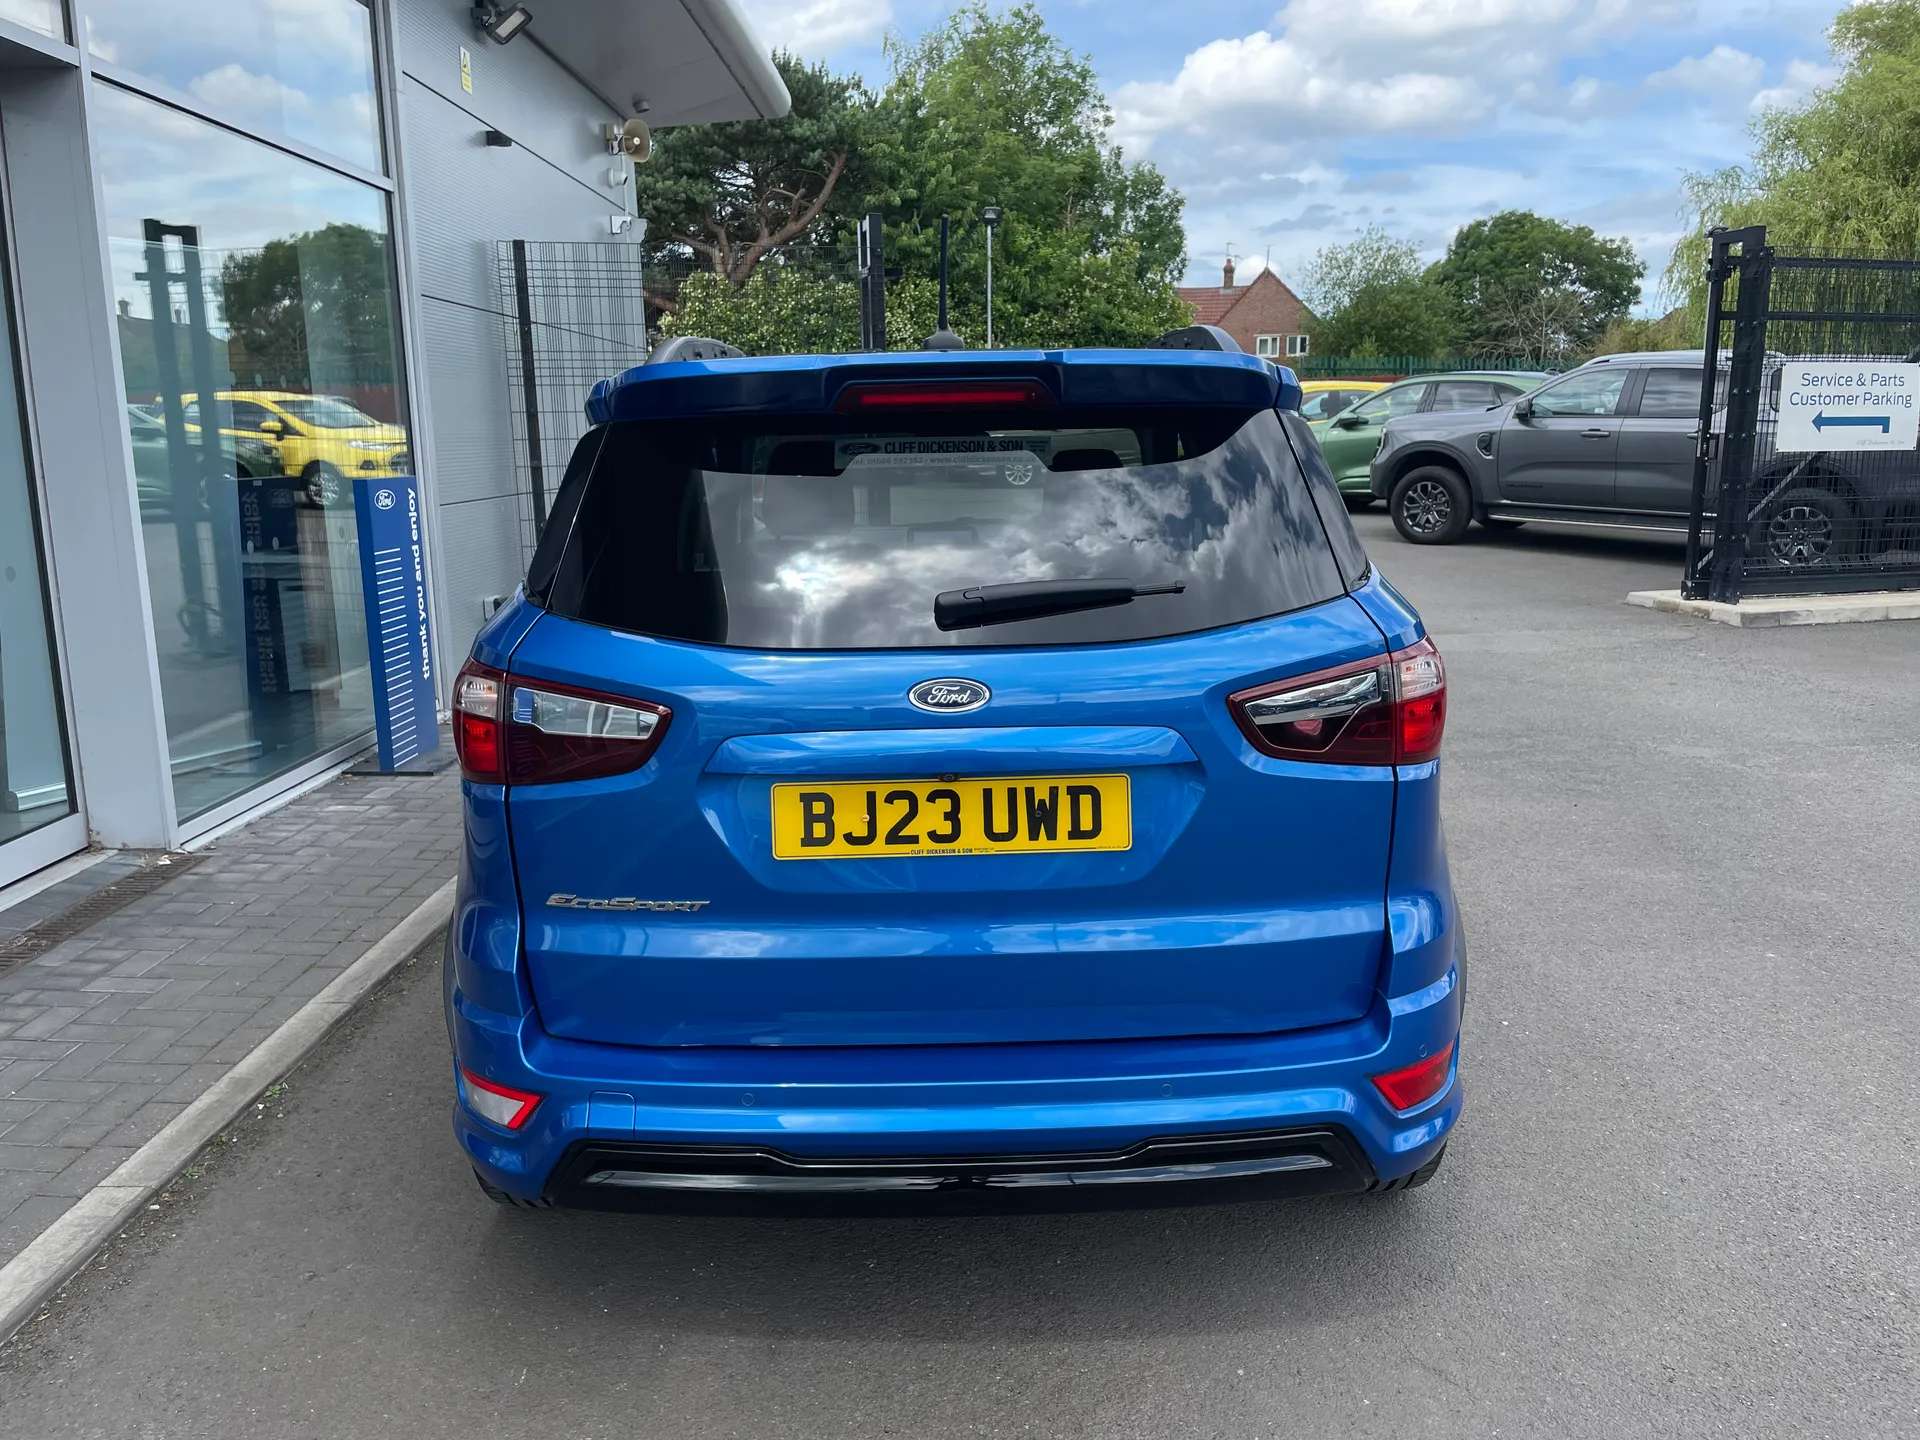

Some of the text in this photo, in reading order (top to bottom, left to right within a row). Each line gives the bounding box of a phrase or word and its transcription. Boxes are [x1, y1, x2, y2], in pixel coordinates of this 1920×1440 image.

[1800, 372, 1905, 387] Service & Parts
[1789, 391, 1912, 408] Customer Parking
[884, 441, 917, 454] CLIFF
[917, 440, 985, 454] DICKENSON
[986, 440, 998, 452] &
[998, 439, 1024, 452] SON
[407, 487, 431, 680] thank you and enjoy
[926, 685, 971, 705] Ford
[799, 784, 1103, 848] BJ23 UWD
